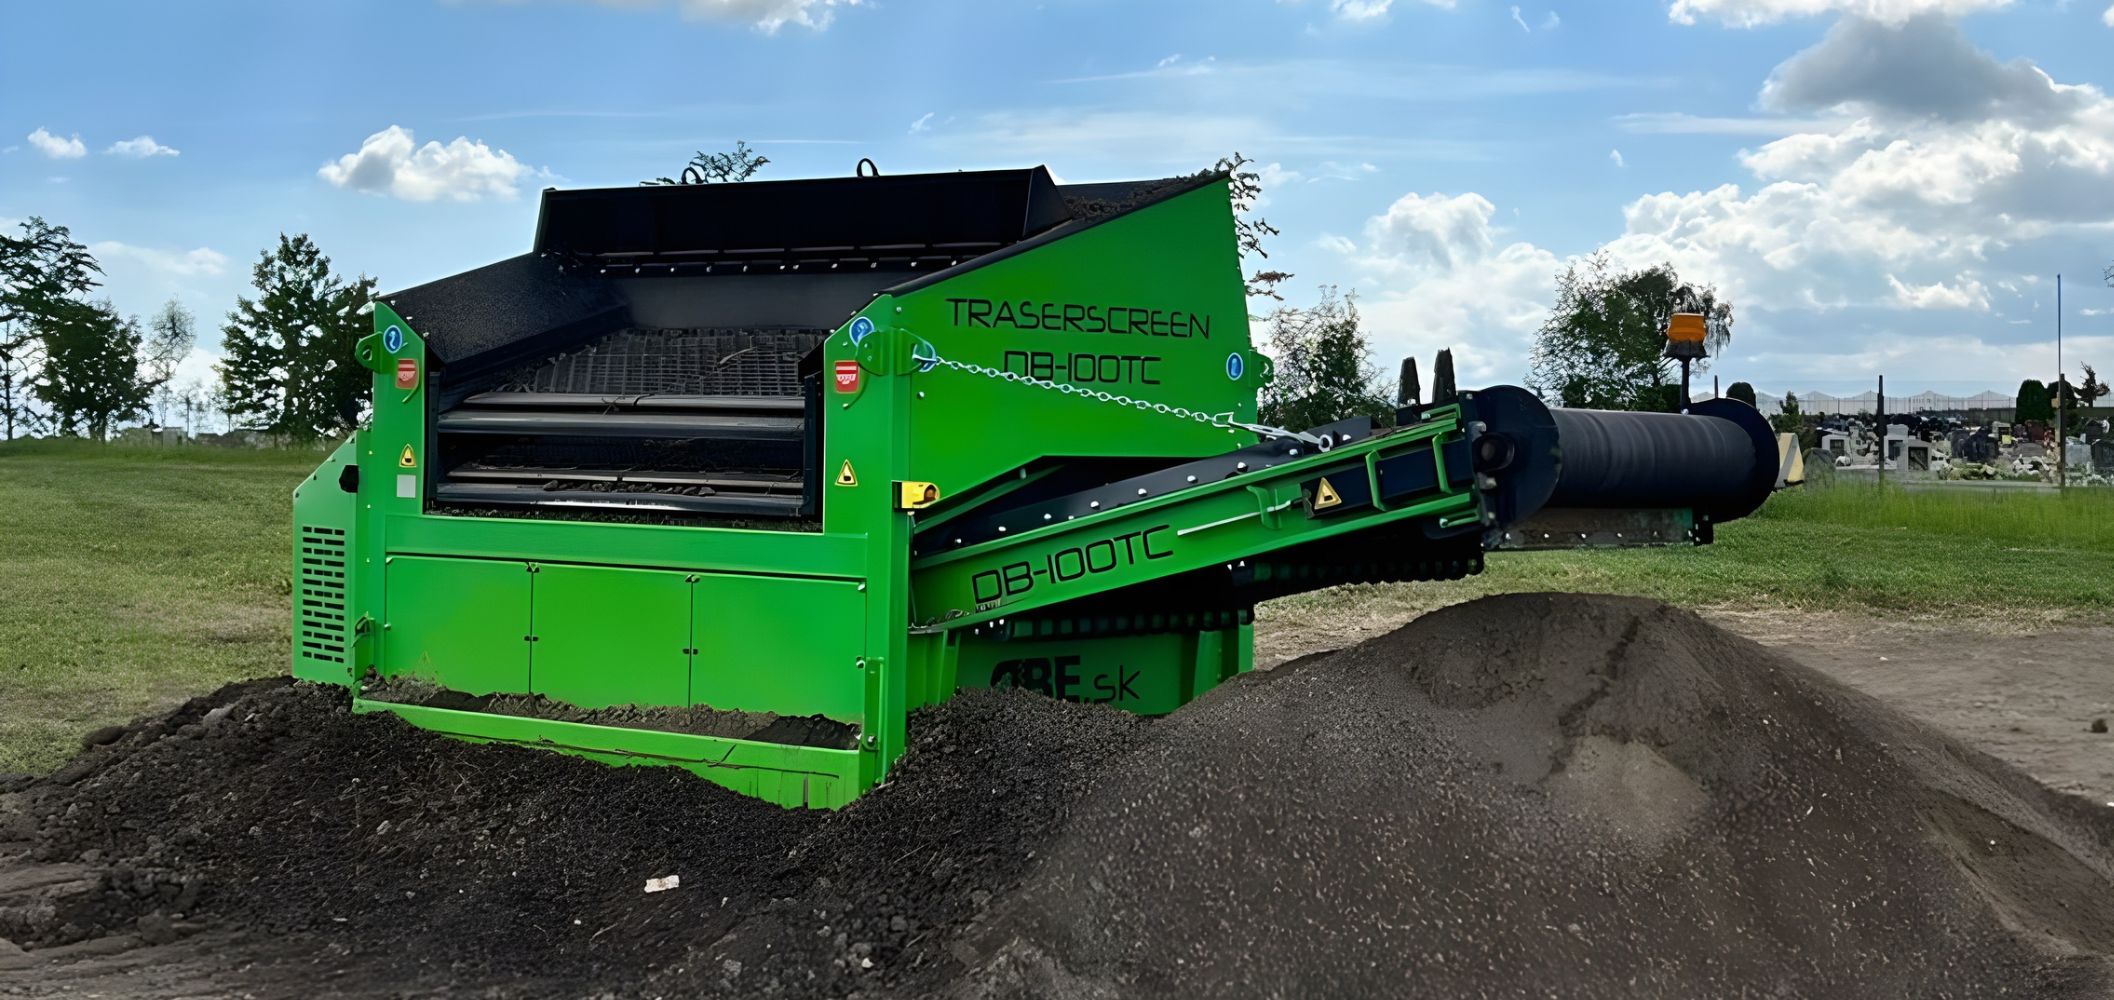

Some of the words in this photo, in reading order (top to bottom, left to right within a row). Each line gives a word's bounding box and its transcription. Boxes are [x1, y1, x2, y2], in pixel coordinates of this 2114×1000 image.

[946, 298, 1209, 339] TRASERSCREEN
[1003, 350, 1160, 385] DB-100TC
[972, 524, 1173, 604] DB-100TC
